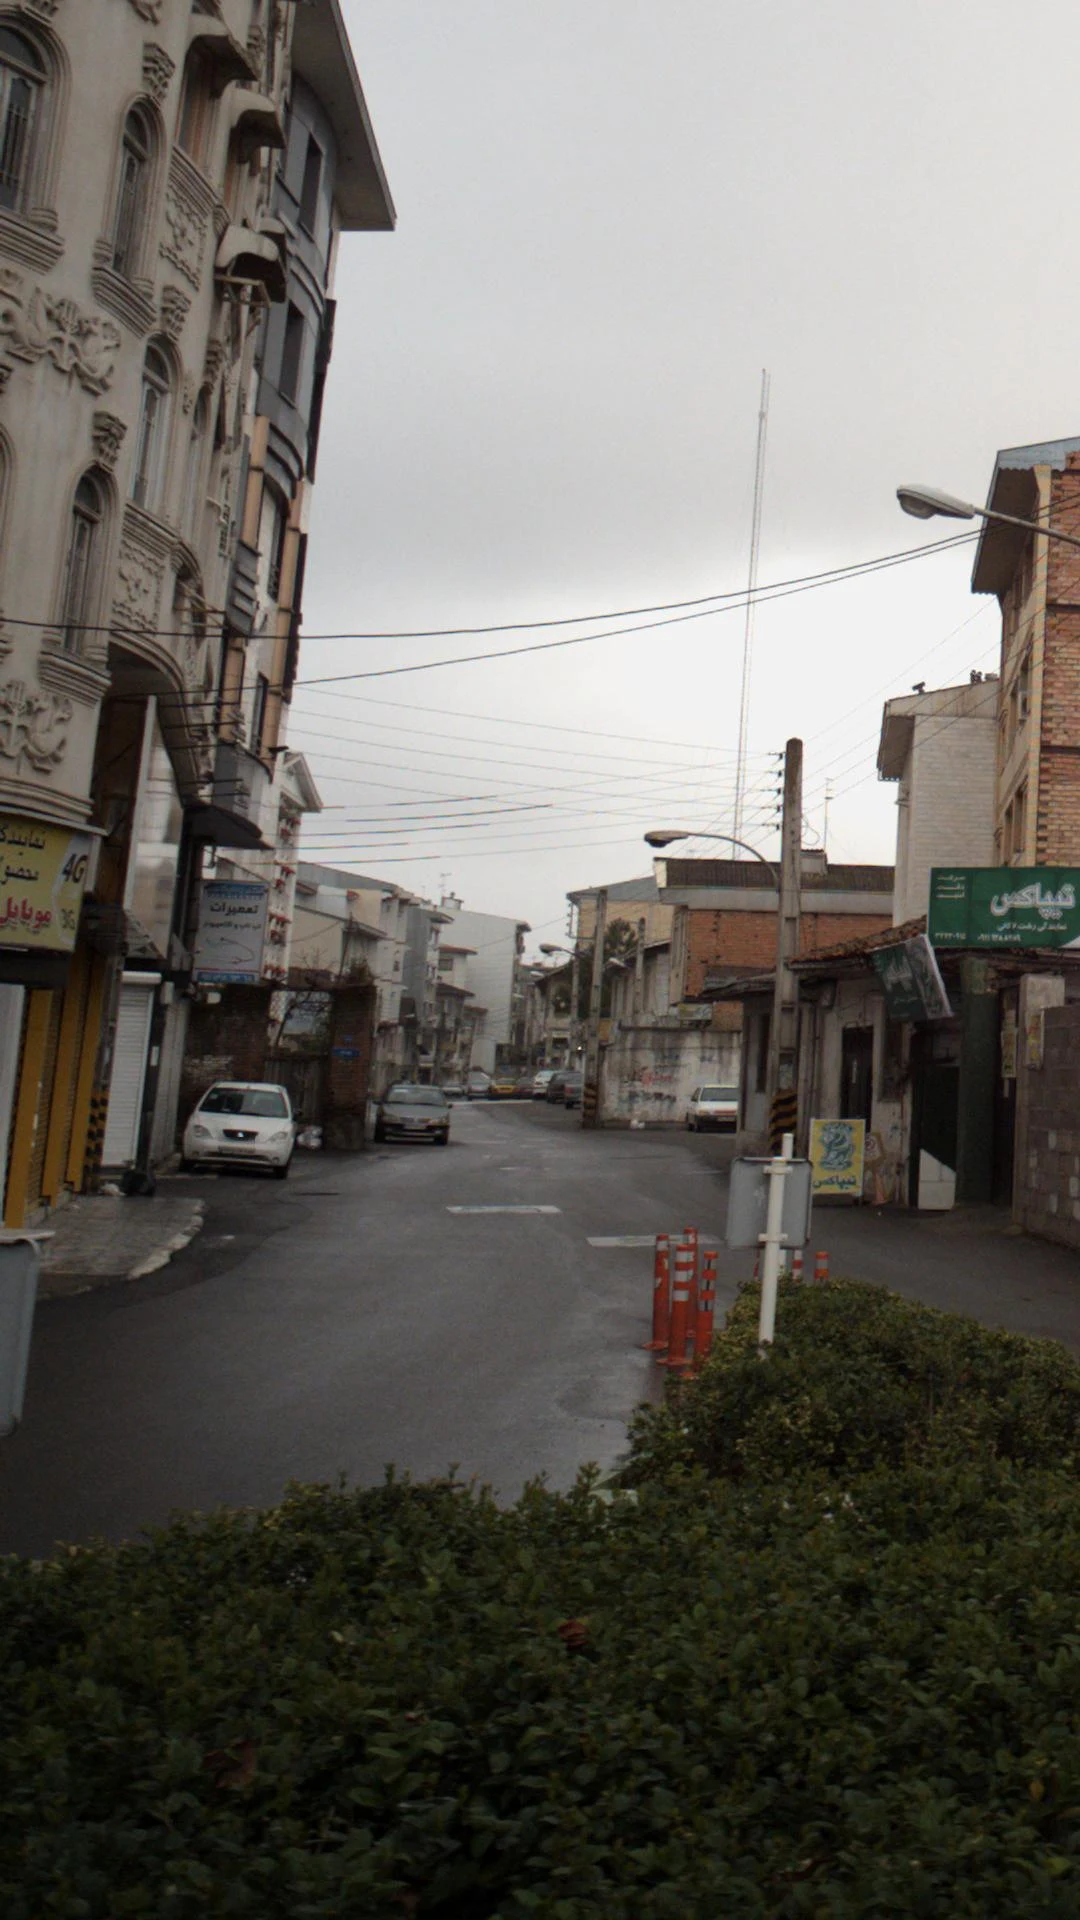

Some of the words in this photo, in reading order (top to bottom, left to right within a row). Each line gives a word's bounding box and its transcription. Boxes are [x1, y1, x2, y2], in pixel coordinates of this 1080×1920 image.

[61, 853, 88, 884] 4G
[210, 901, 259, 917] تعمیرات
[990, 882, 1076, 920] تیپاکس
[812, 1174, 857, 1190] تیپاکس
